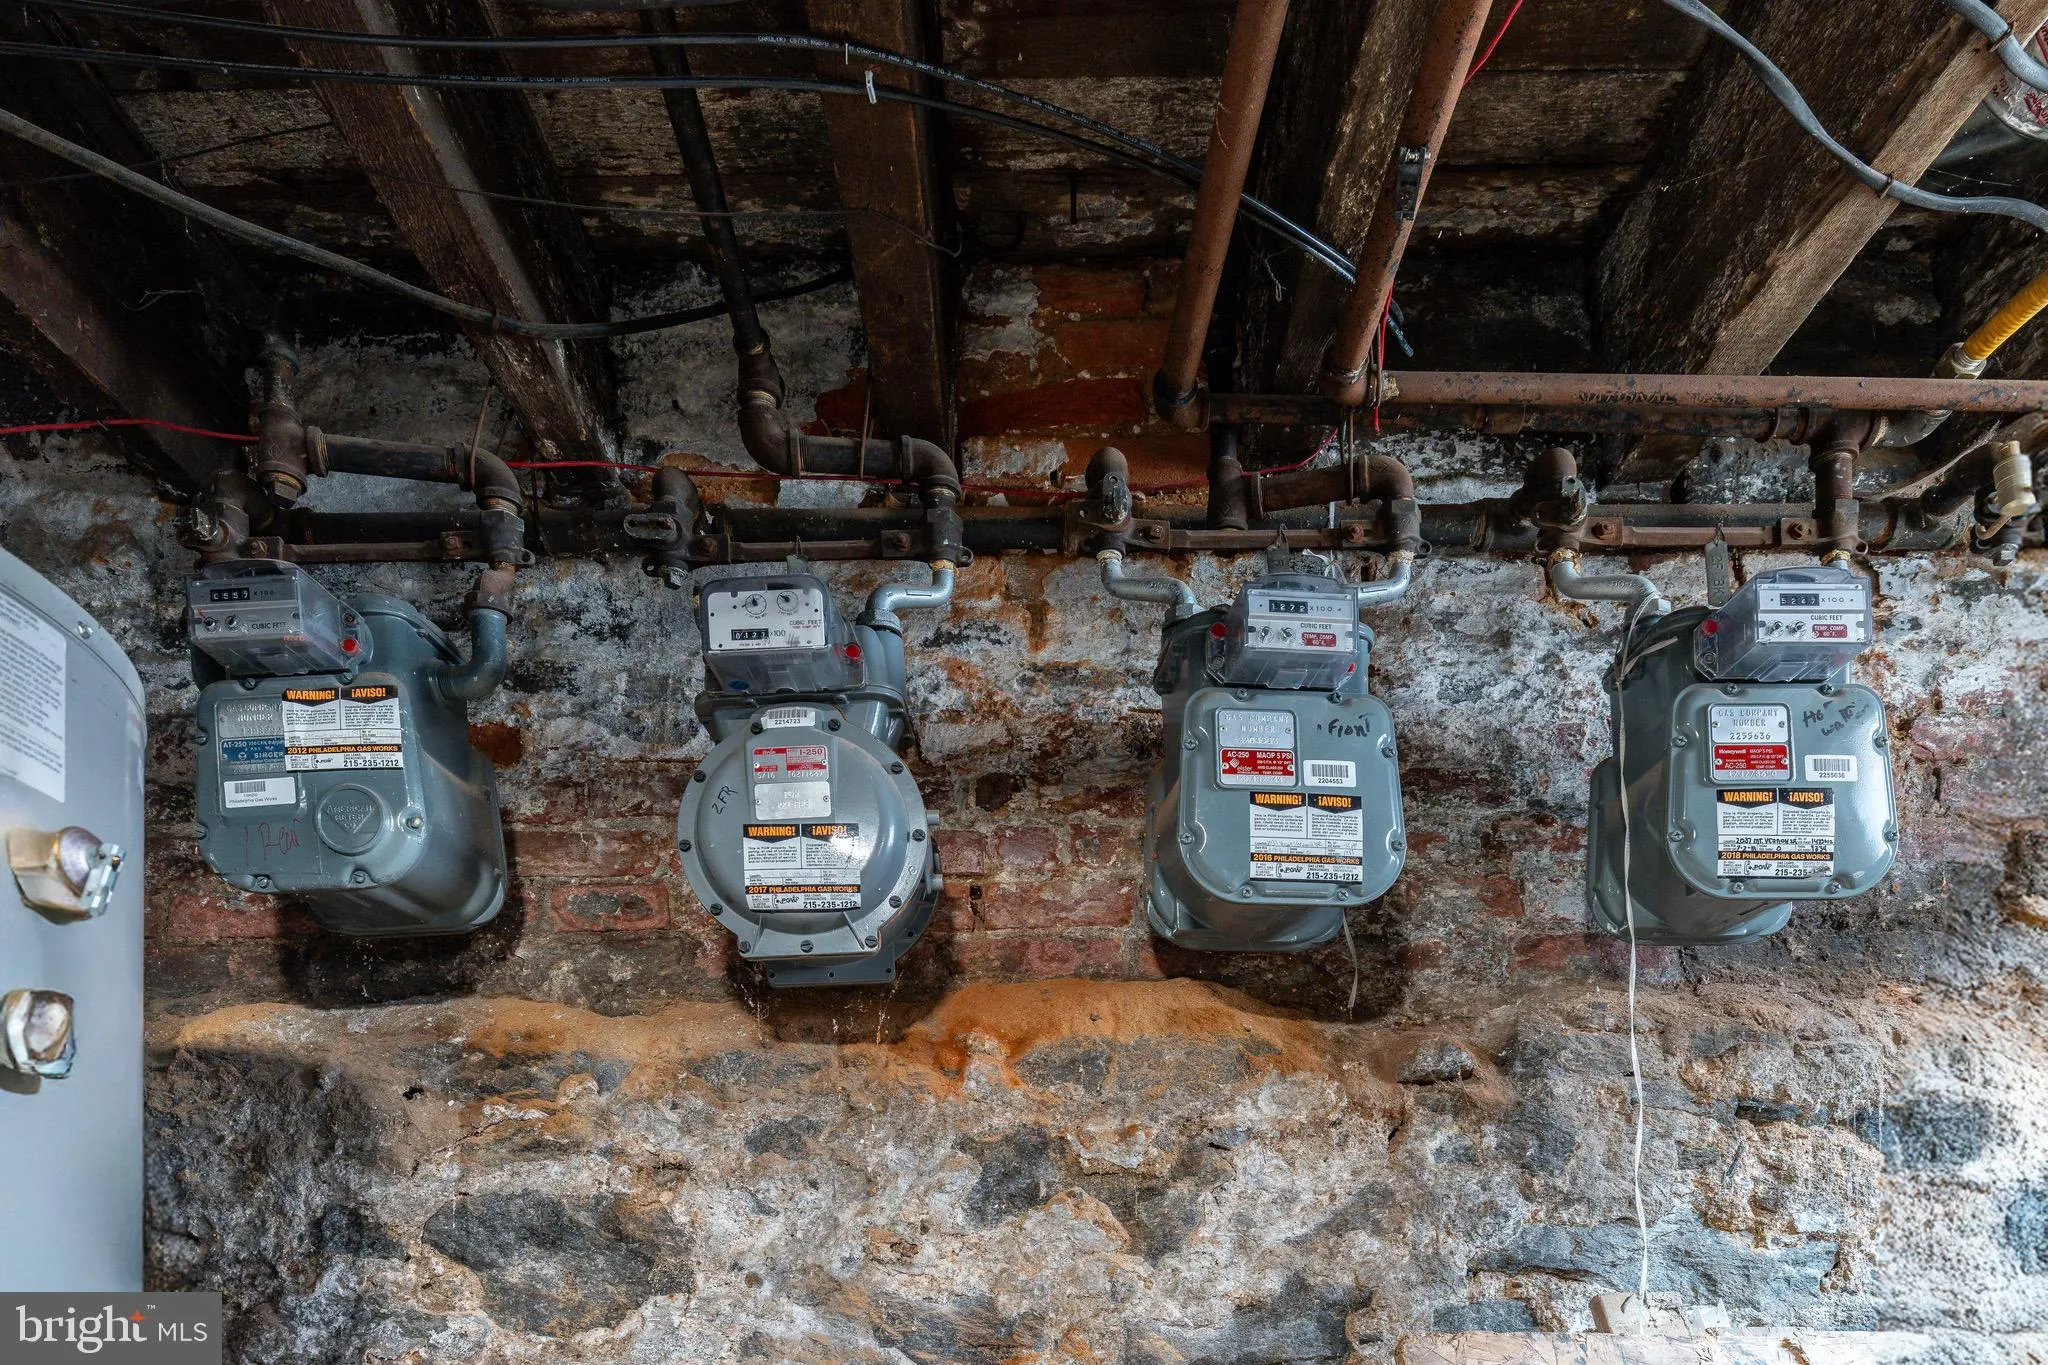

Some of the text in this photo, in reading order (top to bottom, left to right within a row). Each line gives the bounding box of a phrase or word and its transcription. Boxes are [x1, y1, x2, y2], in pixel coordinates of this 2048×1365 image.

[1781, 597, 1816, 605] 5247
[1271, 603, 1306, 613] 1272
[286, 690, 335, 700] WARNING!
[1729, 732, 1771, 741] 2255636
[308, 746, 356, 754] PHILADELPHIA
[1718, 748, 1747, 756] Honeywell
[1227, 751, 1250, 759] AC-250
[1256, 751, 1276, 759] MAOP
[343, 759, 400, 768] 215-235-1212
[1818, 771, 1846, 779] 2255636
[1254, 793, 1302, 805] WARNING!
[1723, 791, 1773, 802] WARNING!
[747, 826, 796, 837] WARNING!
[1253, 854, 1273, 862] 2016
[1273, 855, 1321, 863] PHILADELPHIA
[1336, 857, 1360, 865] WORKS
[1721, 851, 1831, 861] 2018 PHILADELPHIA GAS WORKS
[1306, 871, 1359, 881] 215-235-1212
[748, 885, 858, 894] 2017 PHILADELPHIA GAS WORKS
[803, 900, 857, 909] 215-235-1212
